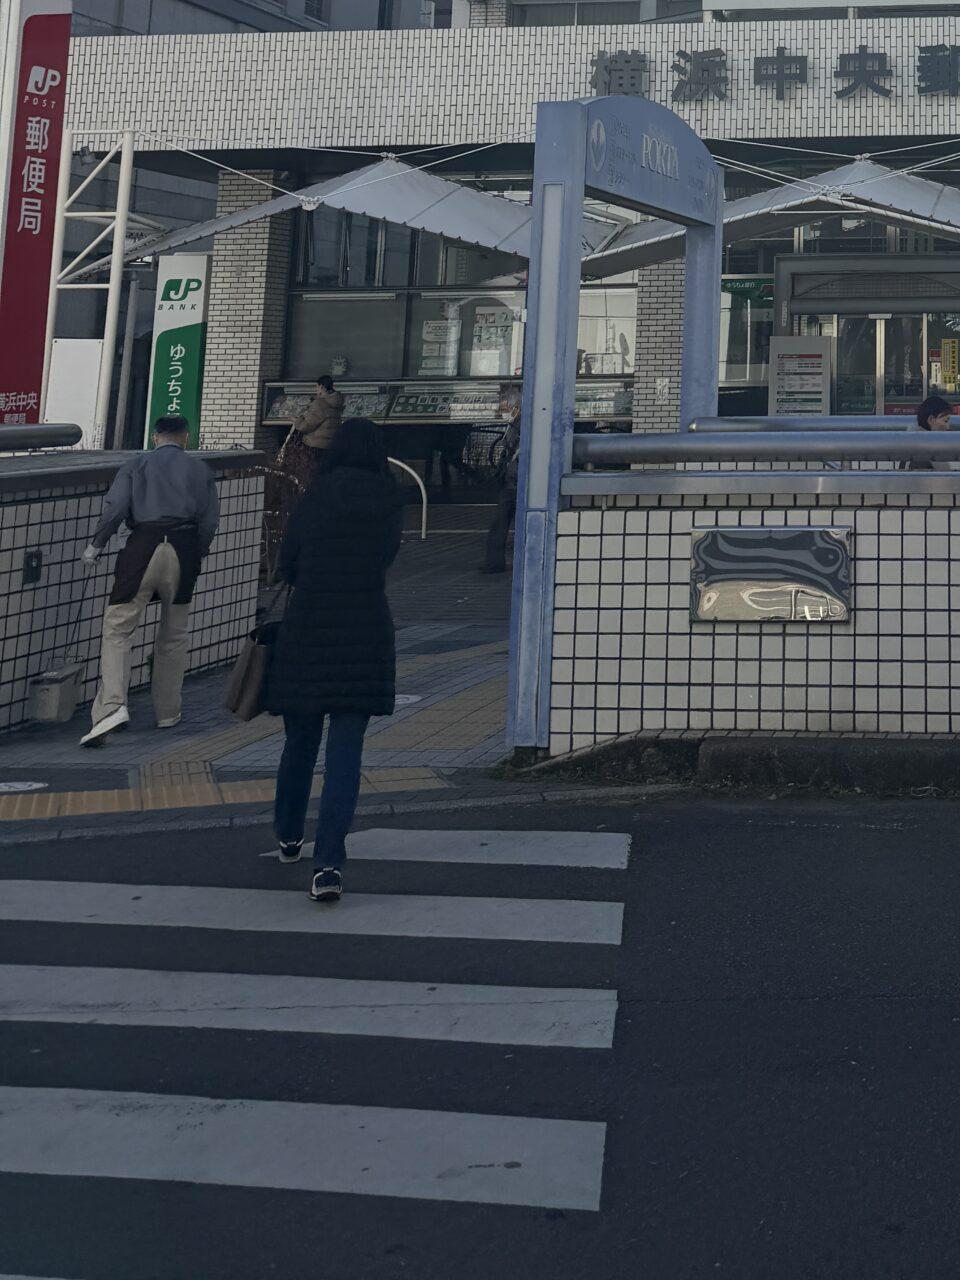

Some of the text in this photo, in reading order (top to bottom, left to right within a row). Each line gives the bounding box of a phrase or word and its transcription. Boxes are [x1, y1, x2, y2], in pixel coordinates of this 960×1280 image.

[23, 95, 56, 110] POST
[17, 116, 50, 235] 郵便局
[157, 303, 198, 311] BANK
[167, 343, 186, 417] ゆうちょ
